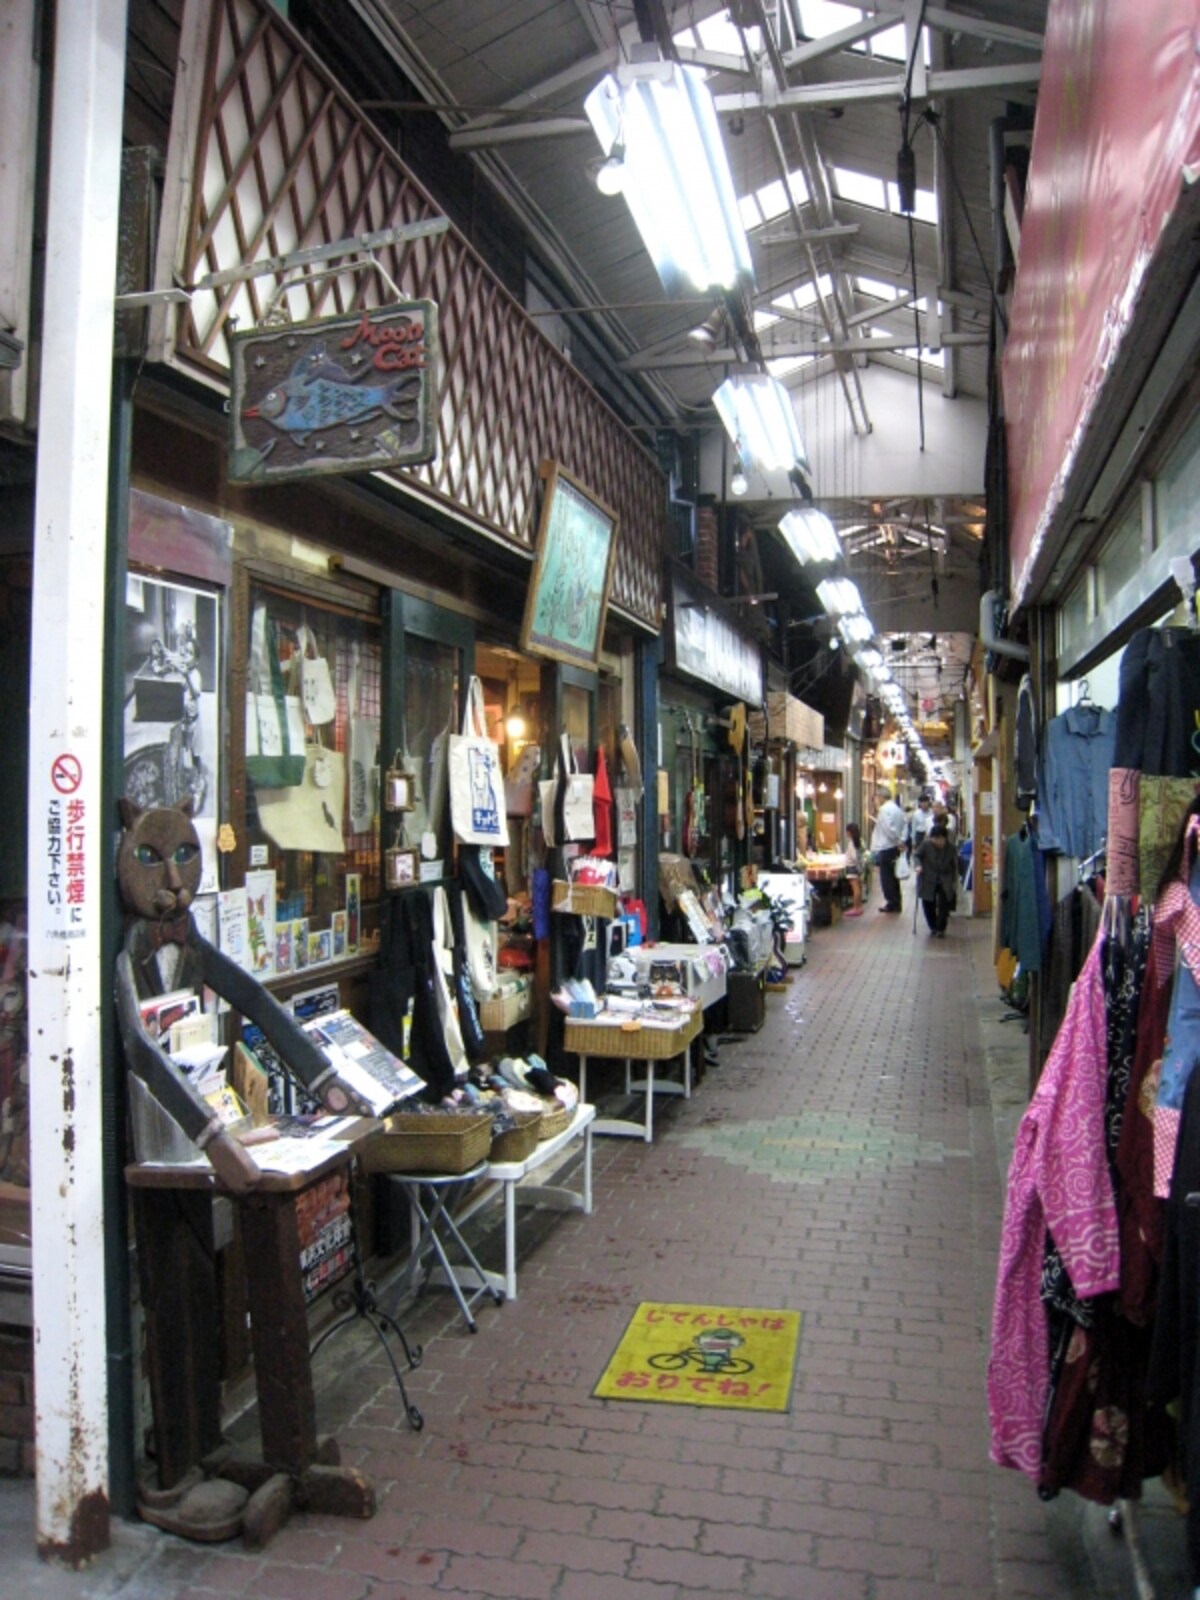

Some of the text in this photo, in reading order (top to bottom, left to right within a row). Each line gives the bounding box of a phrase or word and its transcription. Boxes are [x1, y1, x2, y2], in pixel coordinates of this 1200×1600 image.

[342, 313, 424, 348] Moon
[374, 343, 427, 370] Cat
[646, 1309, 786, 1330] じてんしゃは
[616, 1371, 773, 1397] おりてね!
